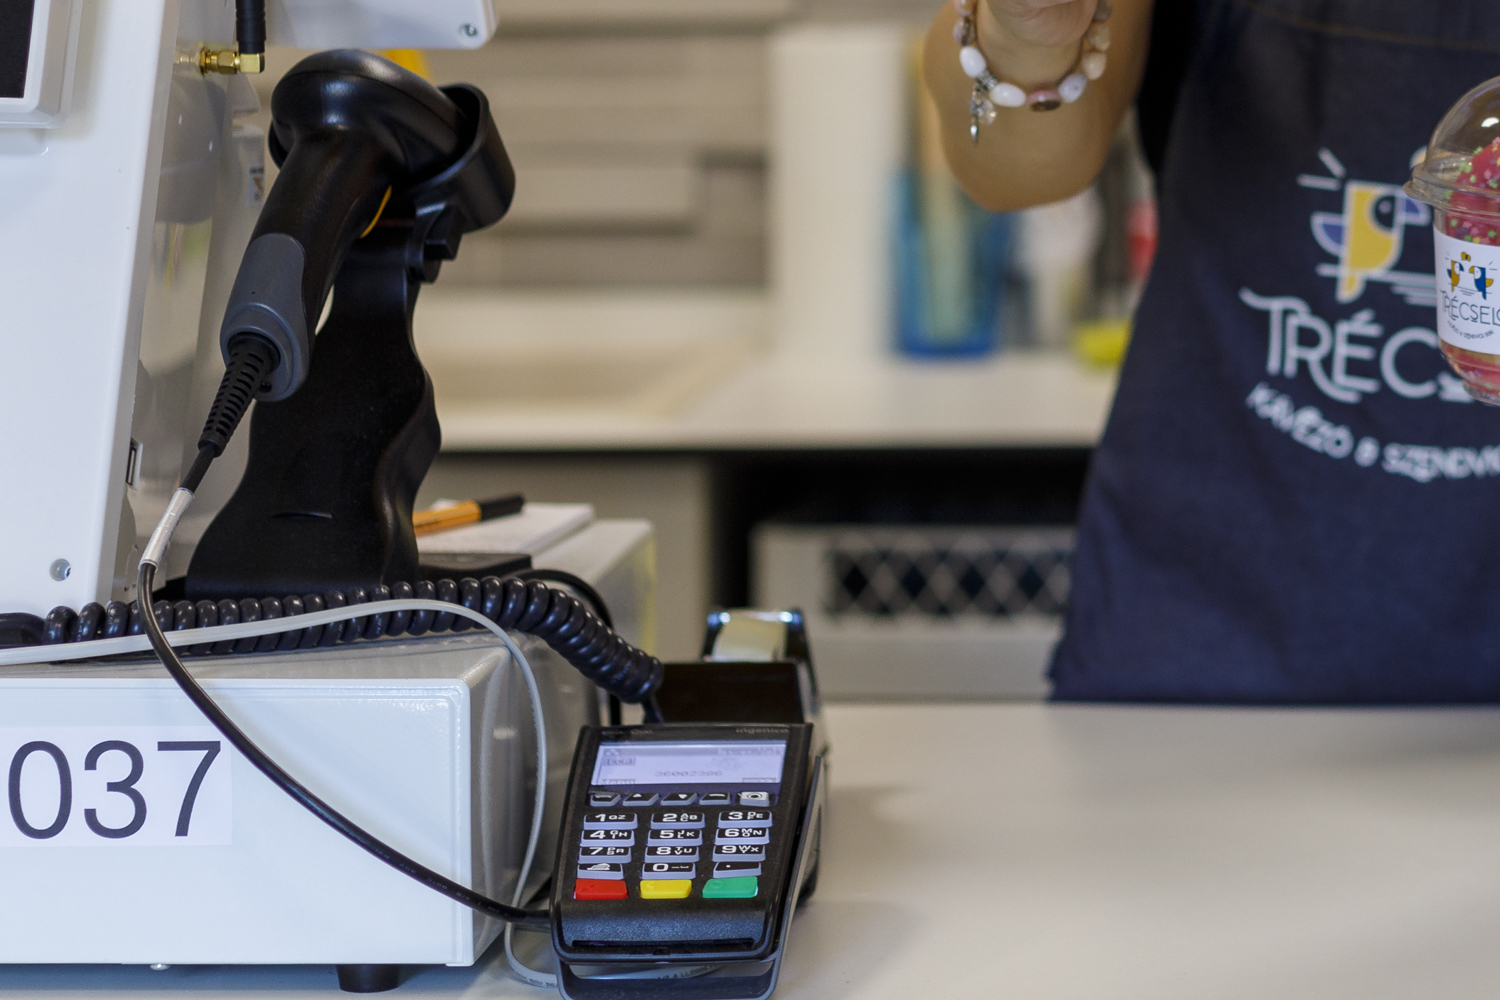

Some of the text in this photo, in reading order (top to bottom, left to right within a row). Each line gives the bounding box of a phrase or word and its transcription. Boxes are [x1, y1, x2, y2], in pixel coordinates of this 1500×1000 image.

[8, 740, 221, 839] 037
[594, 813, 607, 822] 1
[662, 813, 678, 822] 2
[728, 811, 743, 820] 3
[589, 830, 606, 839] 4
[659, 829, 674, 839] 5
[724, 828, 740, 837] 6
[589, 847, 604, 855] 7
[656, 846, 672, 855] 8
[721, 845, 737, 853] 9
